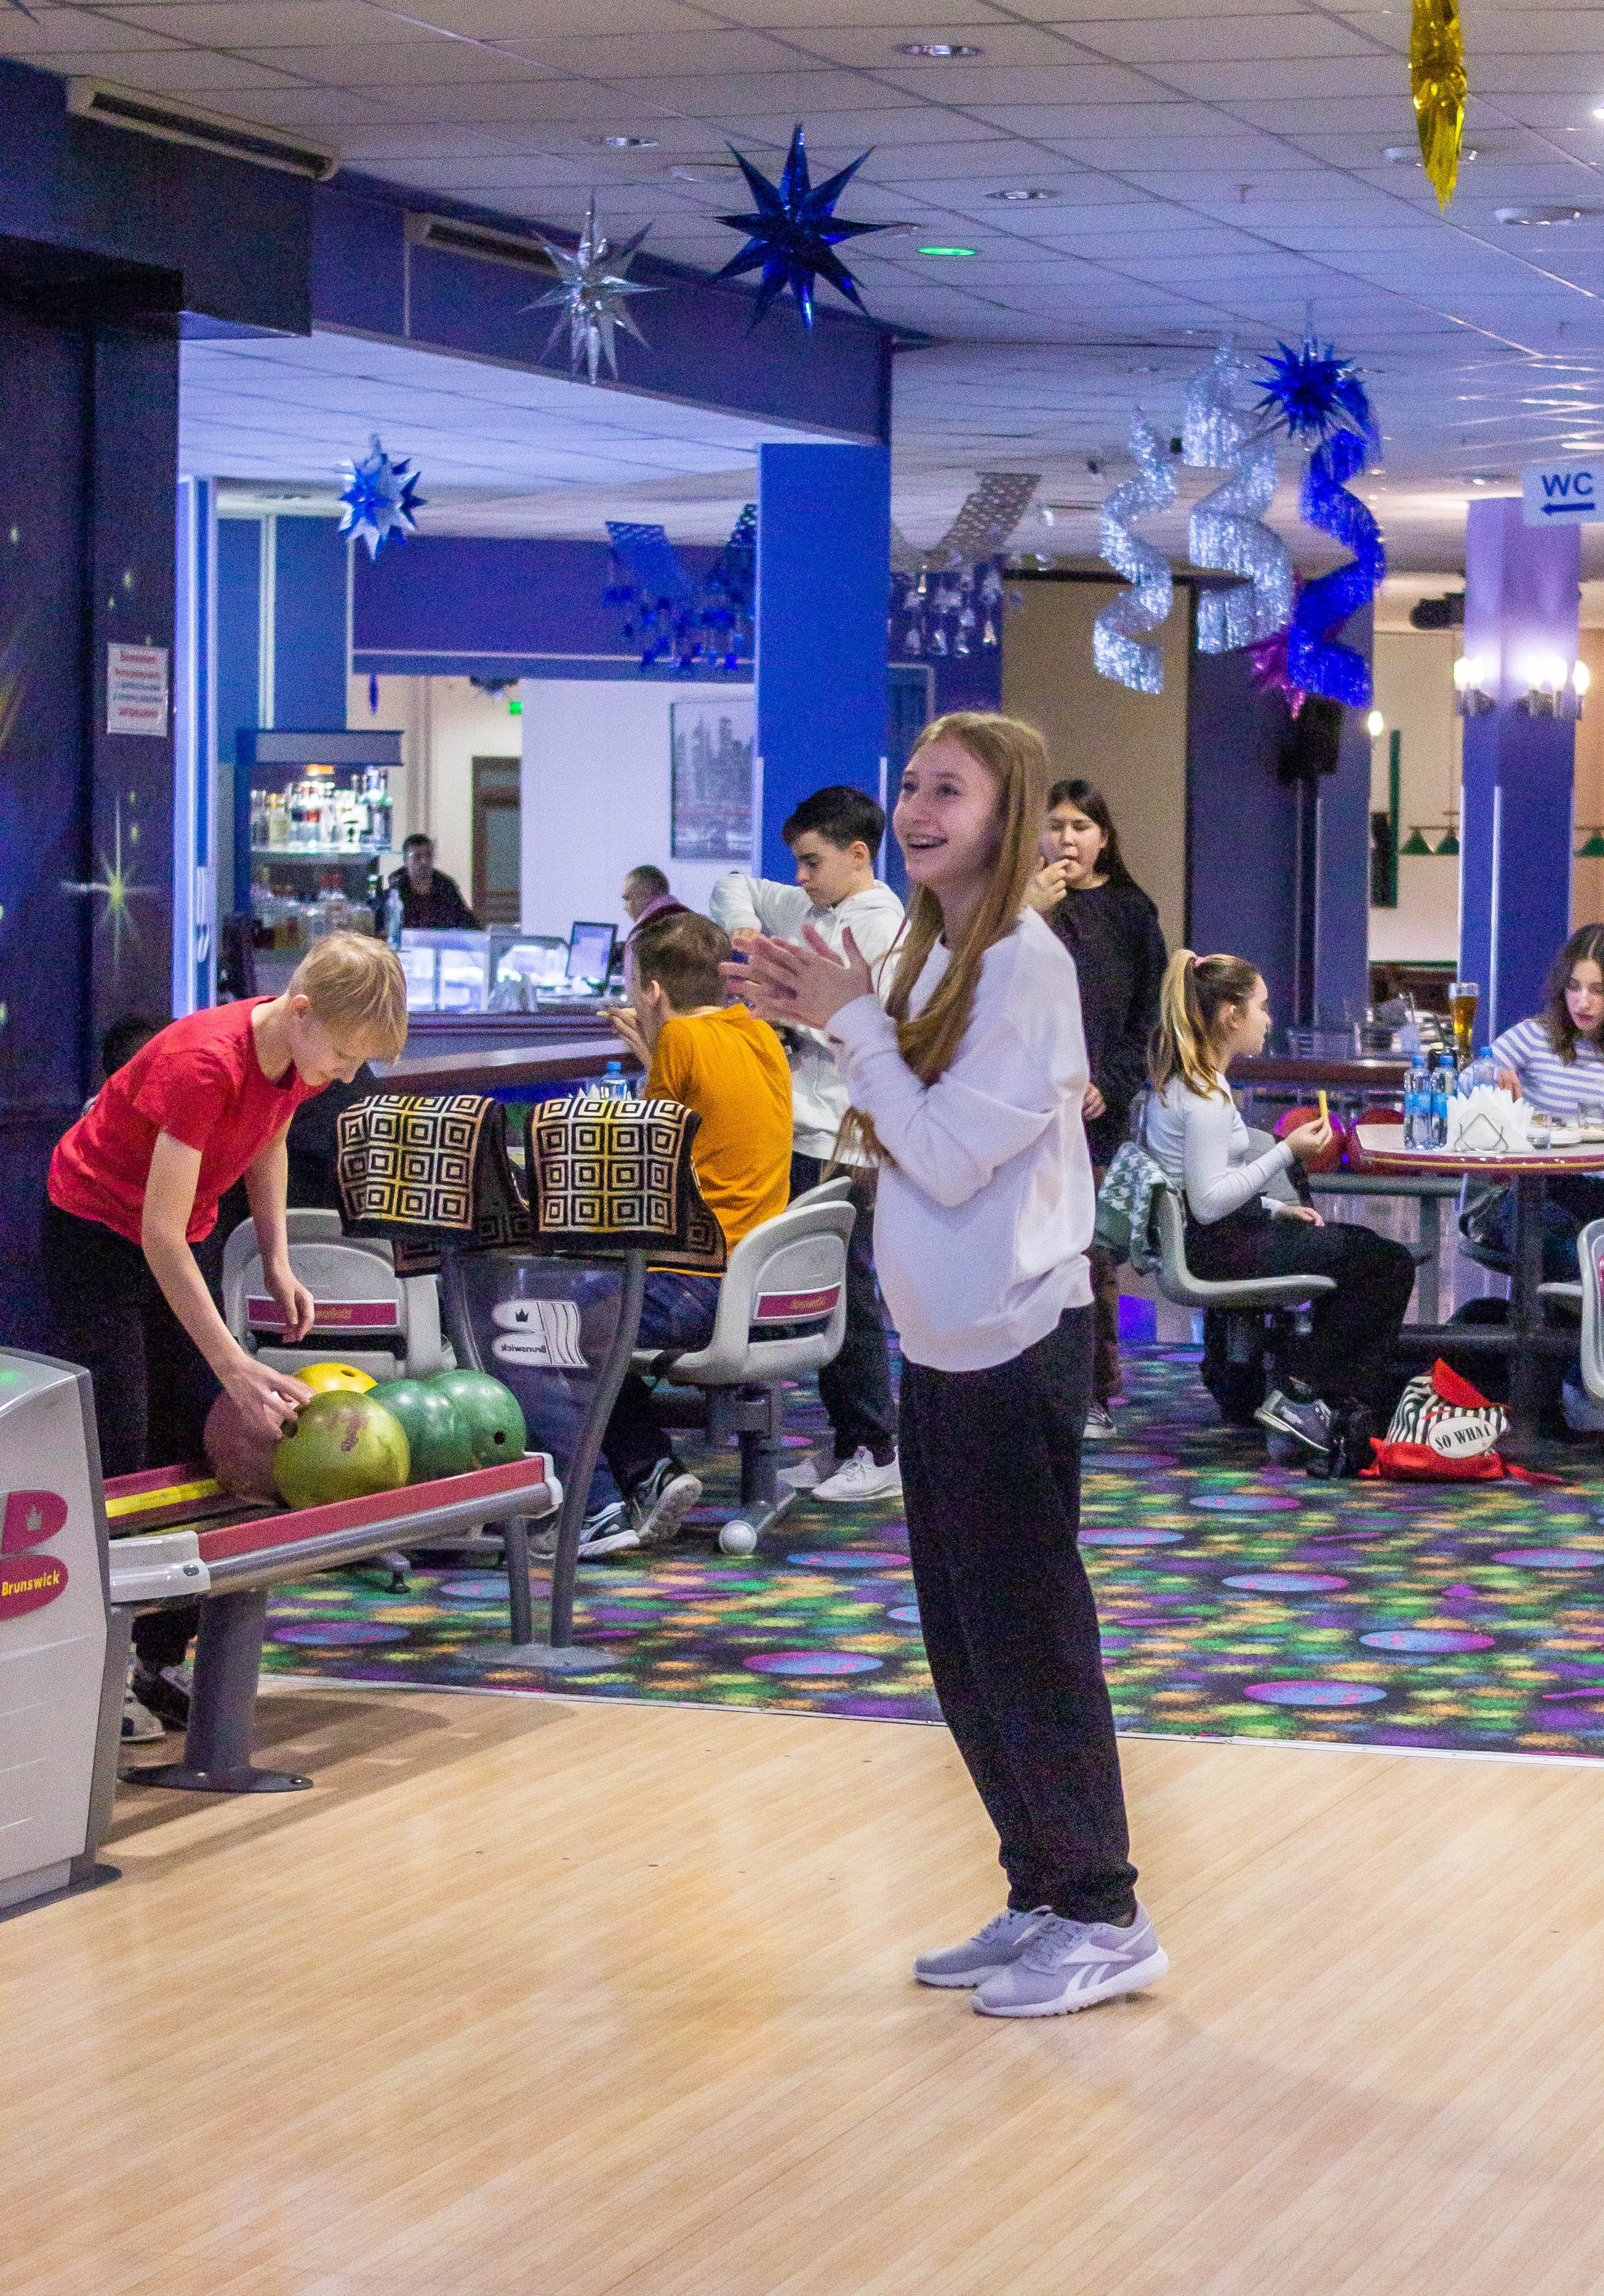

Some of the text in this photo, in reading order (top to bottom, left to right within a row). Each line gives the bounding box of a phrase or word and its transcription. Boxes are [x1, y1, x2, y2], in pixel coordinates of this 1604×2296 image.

[1541, 472, 1594, 497] WC
[1435, 1434, 1452, 1450] SO
[1, 1570, 60, 1597] Brunswick
